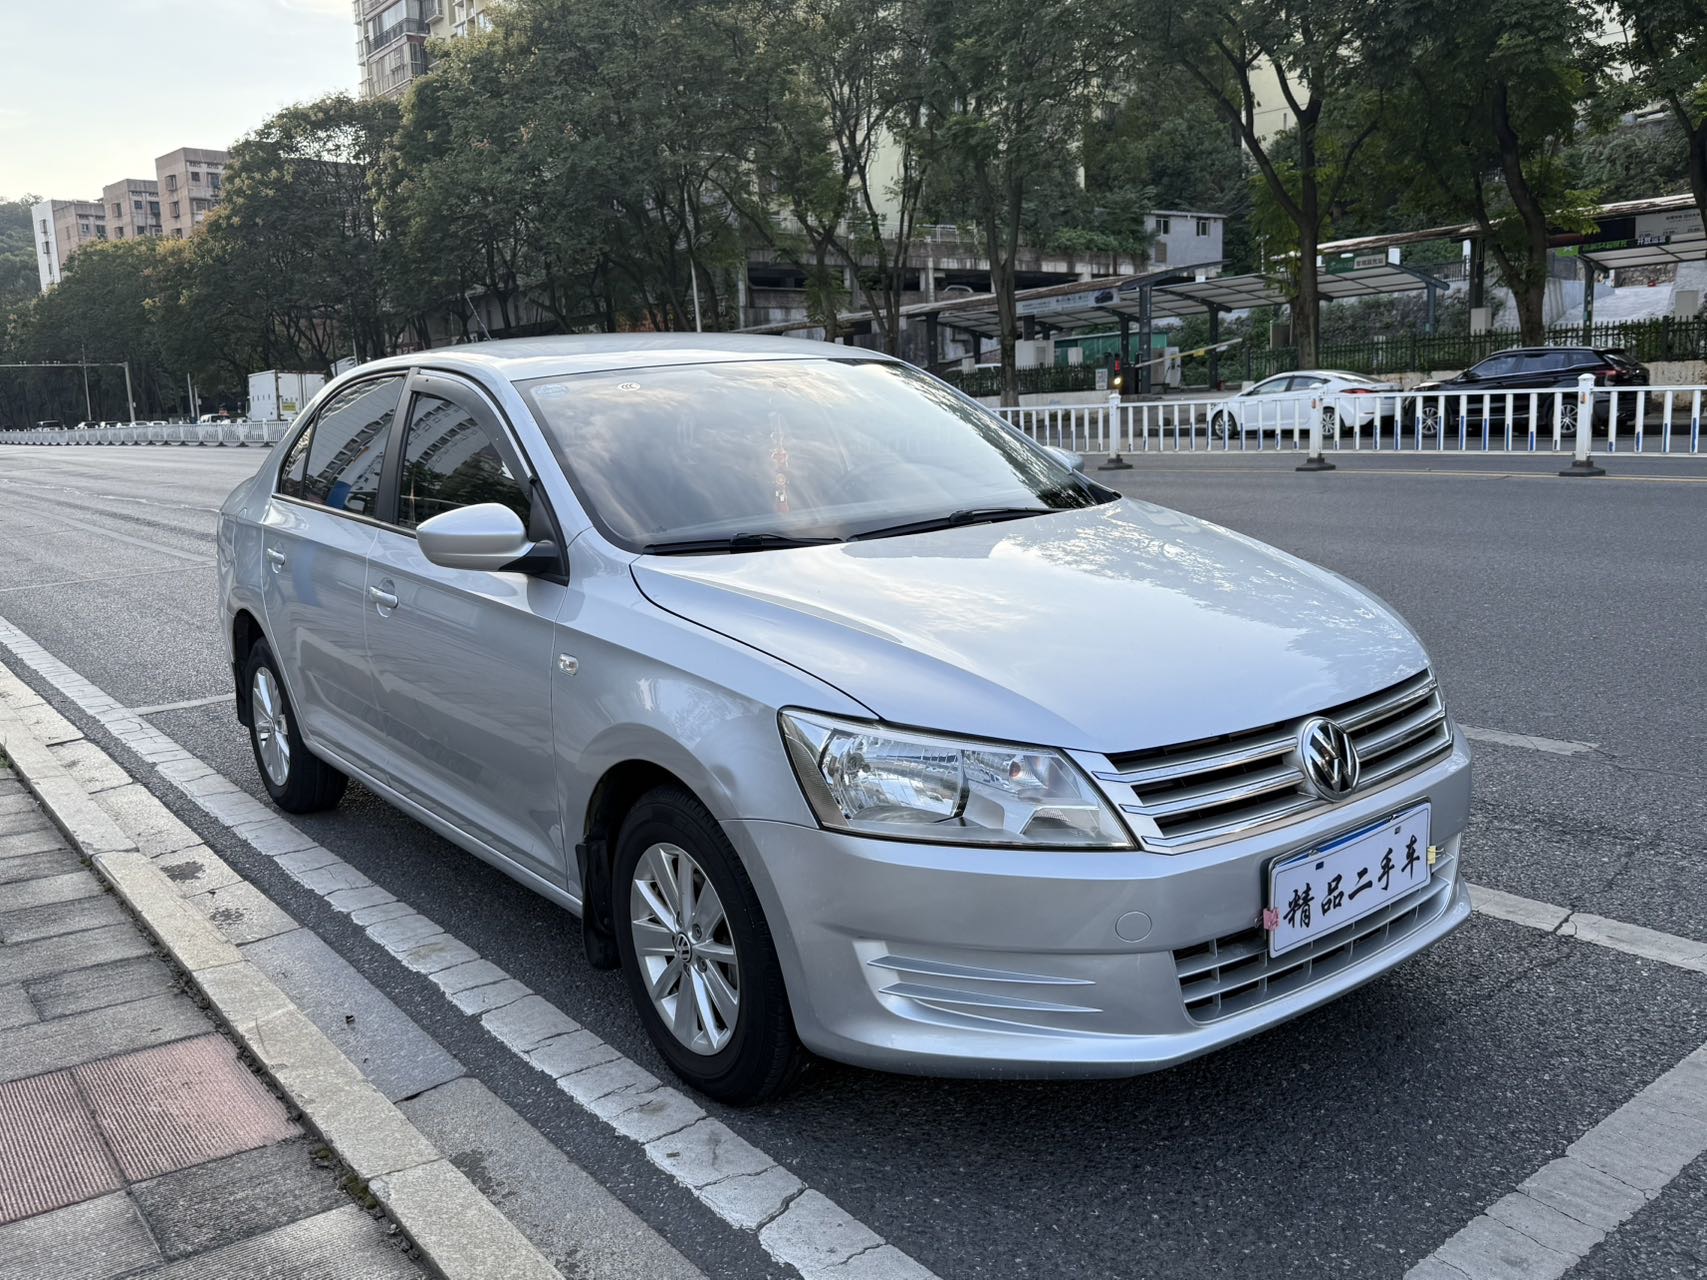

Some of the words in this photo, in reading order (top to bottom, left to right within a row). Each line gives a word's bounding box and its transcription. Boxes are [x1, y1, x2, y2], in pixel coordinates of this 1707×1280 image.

[1283, 834, 1420, 928] 精品二手车
